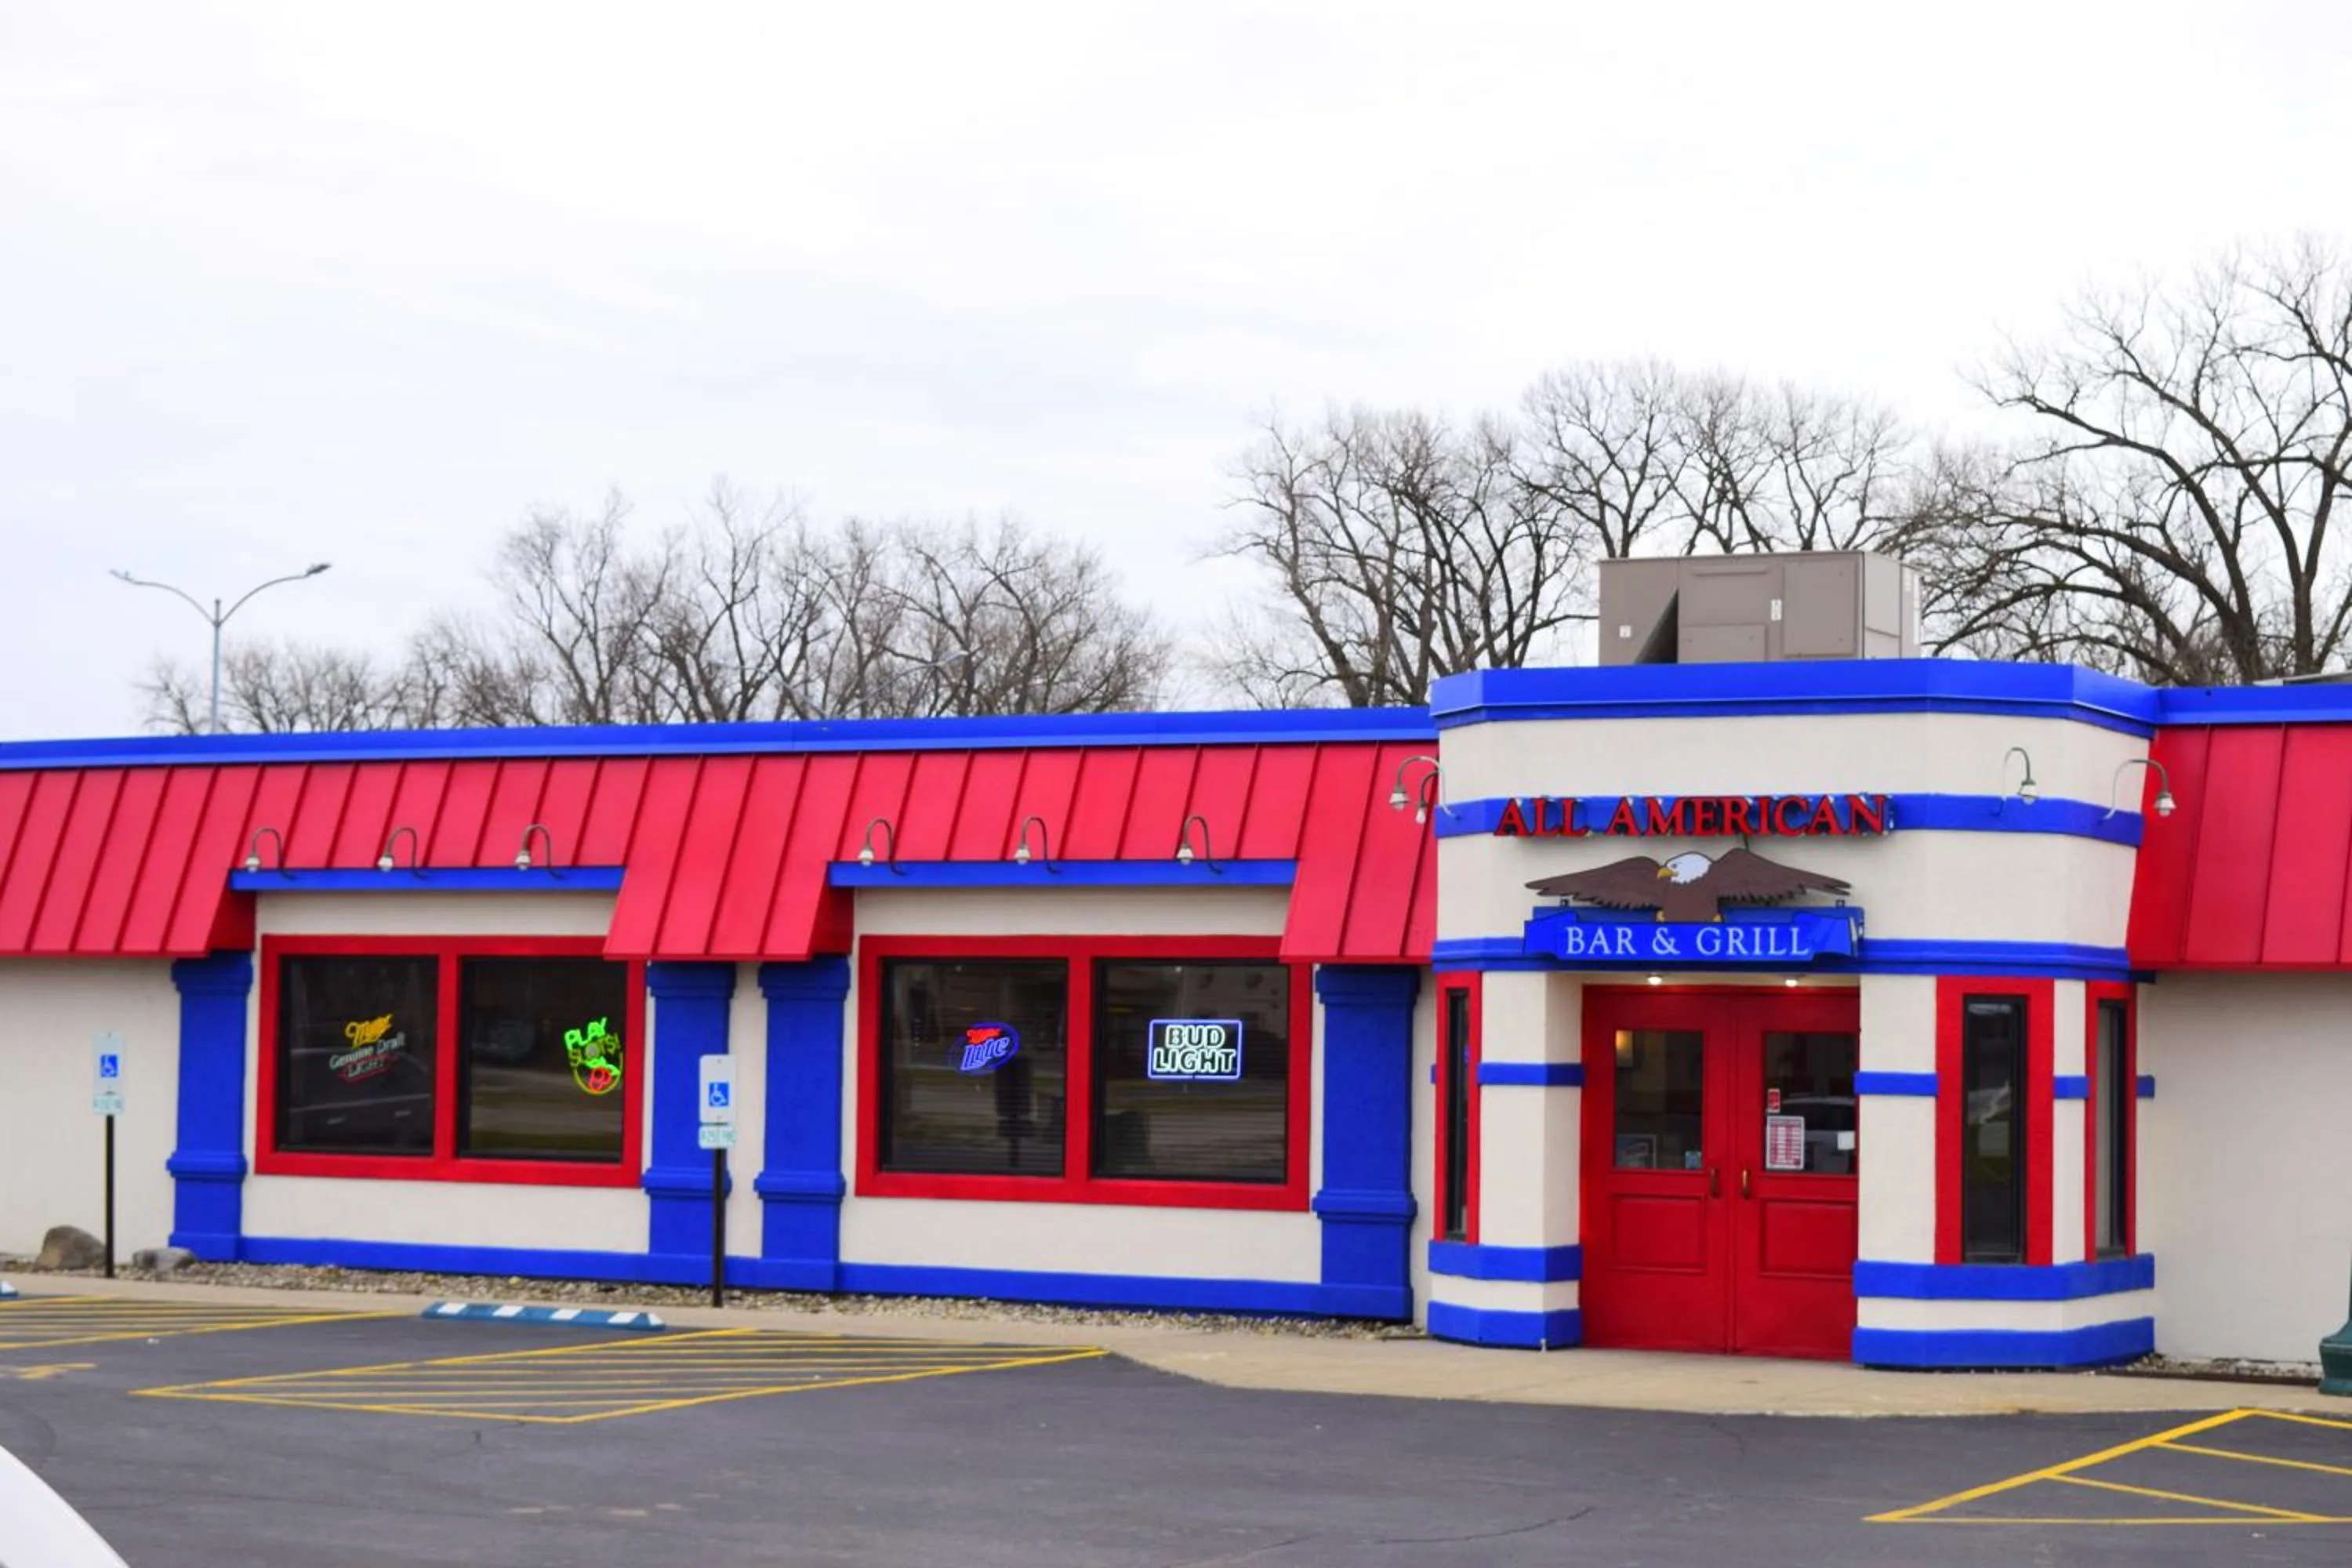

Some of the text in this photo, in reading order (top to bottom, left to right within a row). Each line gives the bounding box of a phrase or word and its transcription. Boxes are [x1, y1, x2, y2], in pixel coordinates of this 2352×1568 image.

[1494, 794, 1891, 837] ALL AMERICAN
[1566, 926, 1810, 956] BAR & GRILL
[564, 1017, 608, 1051] PLAY
[1165, 1025, 1225, 1048] BUD
[1153, 1047, 1236, 1073] LIGHT
